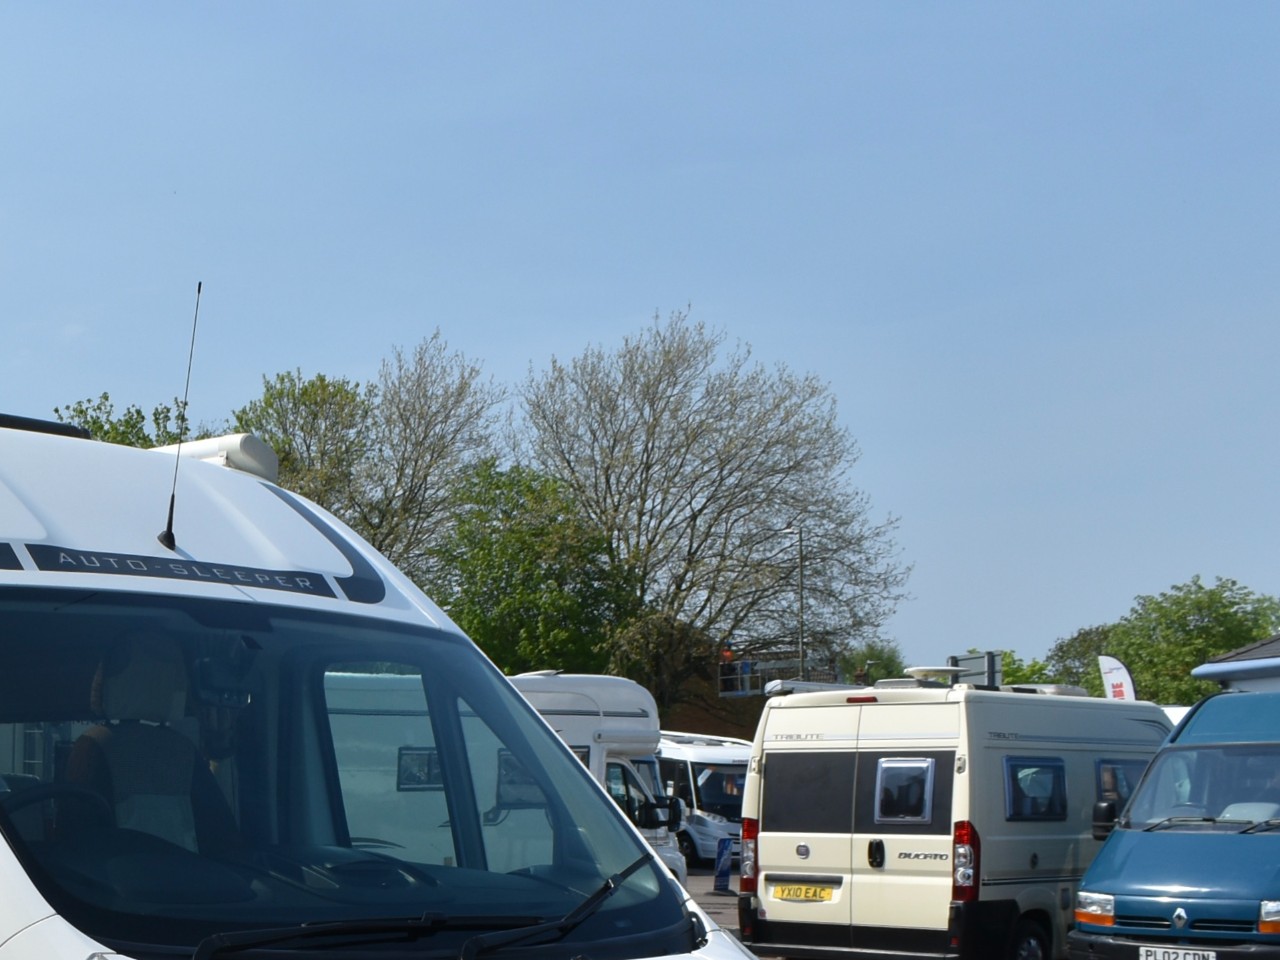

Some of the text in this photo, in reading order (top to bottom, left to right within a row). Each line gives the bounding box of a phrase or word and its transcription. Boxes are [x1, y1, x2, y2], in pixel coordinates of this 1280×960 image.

[58, 552, 315, 590] AUTO-SLEEPER
[898, 852, 949, 861] DUCATO
[780, 887, 826, 899] YX10 EAC
